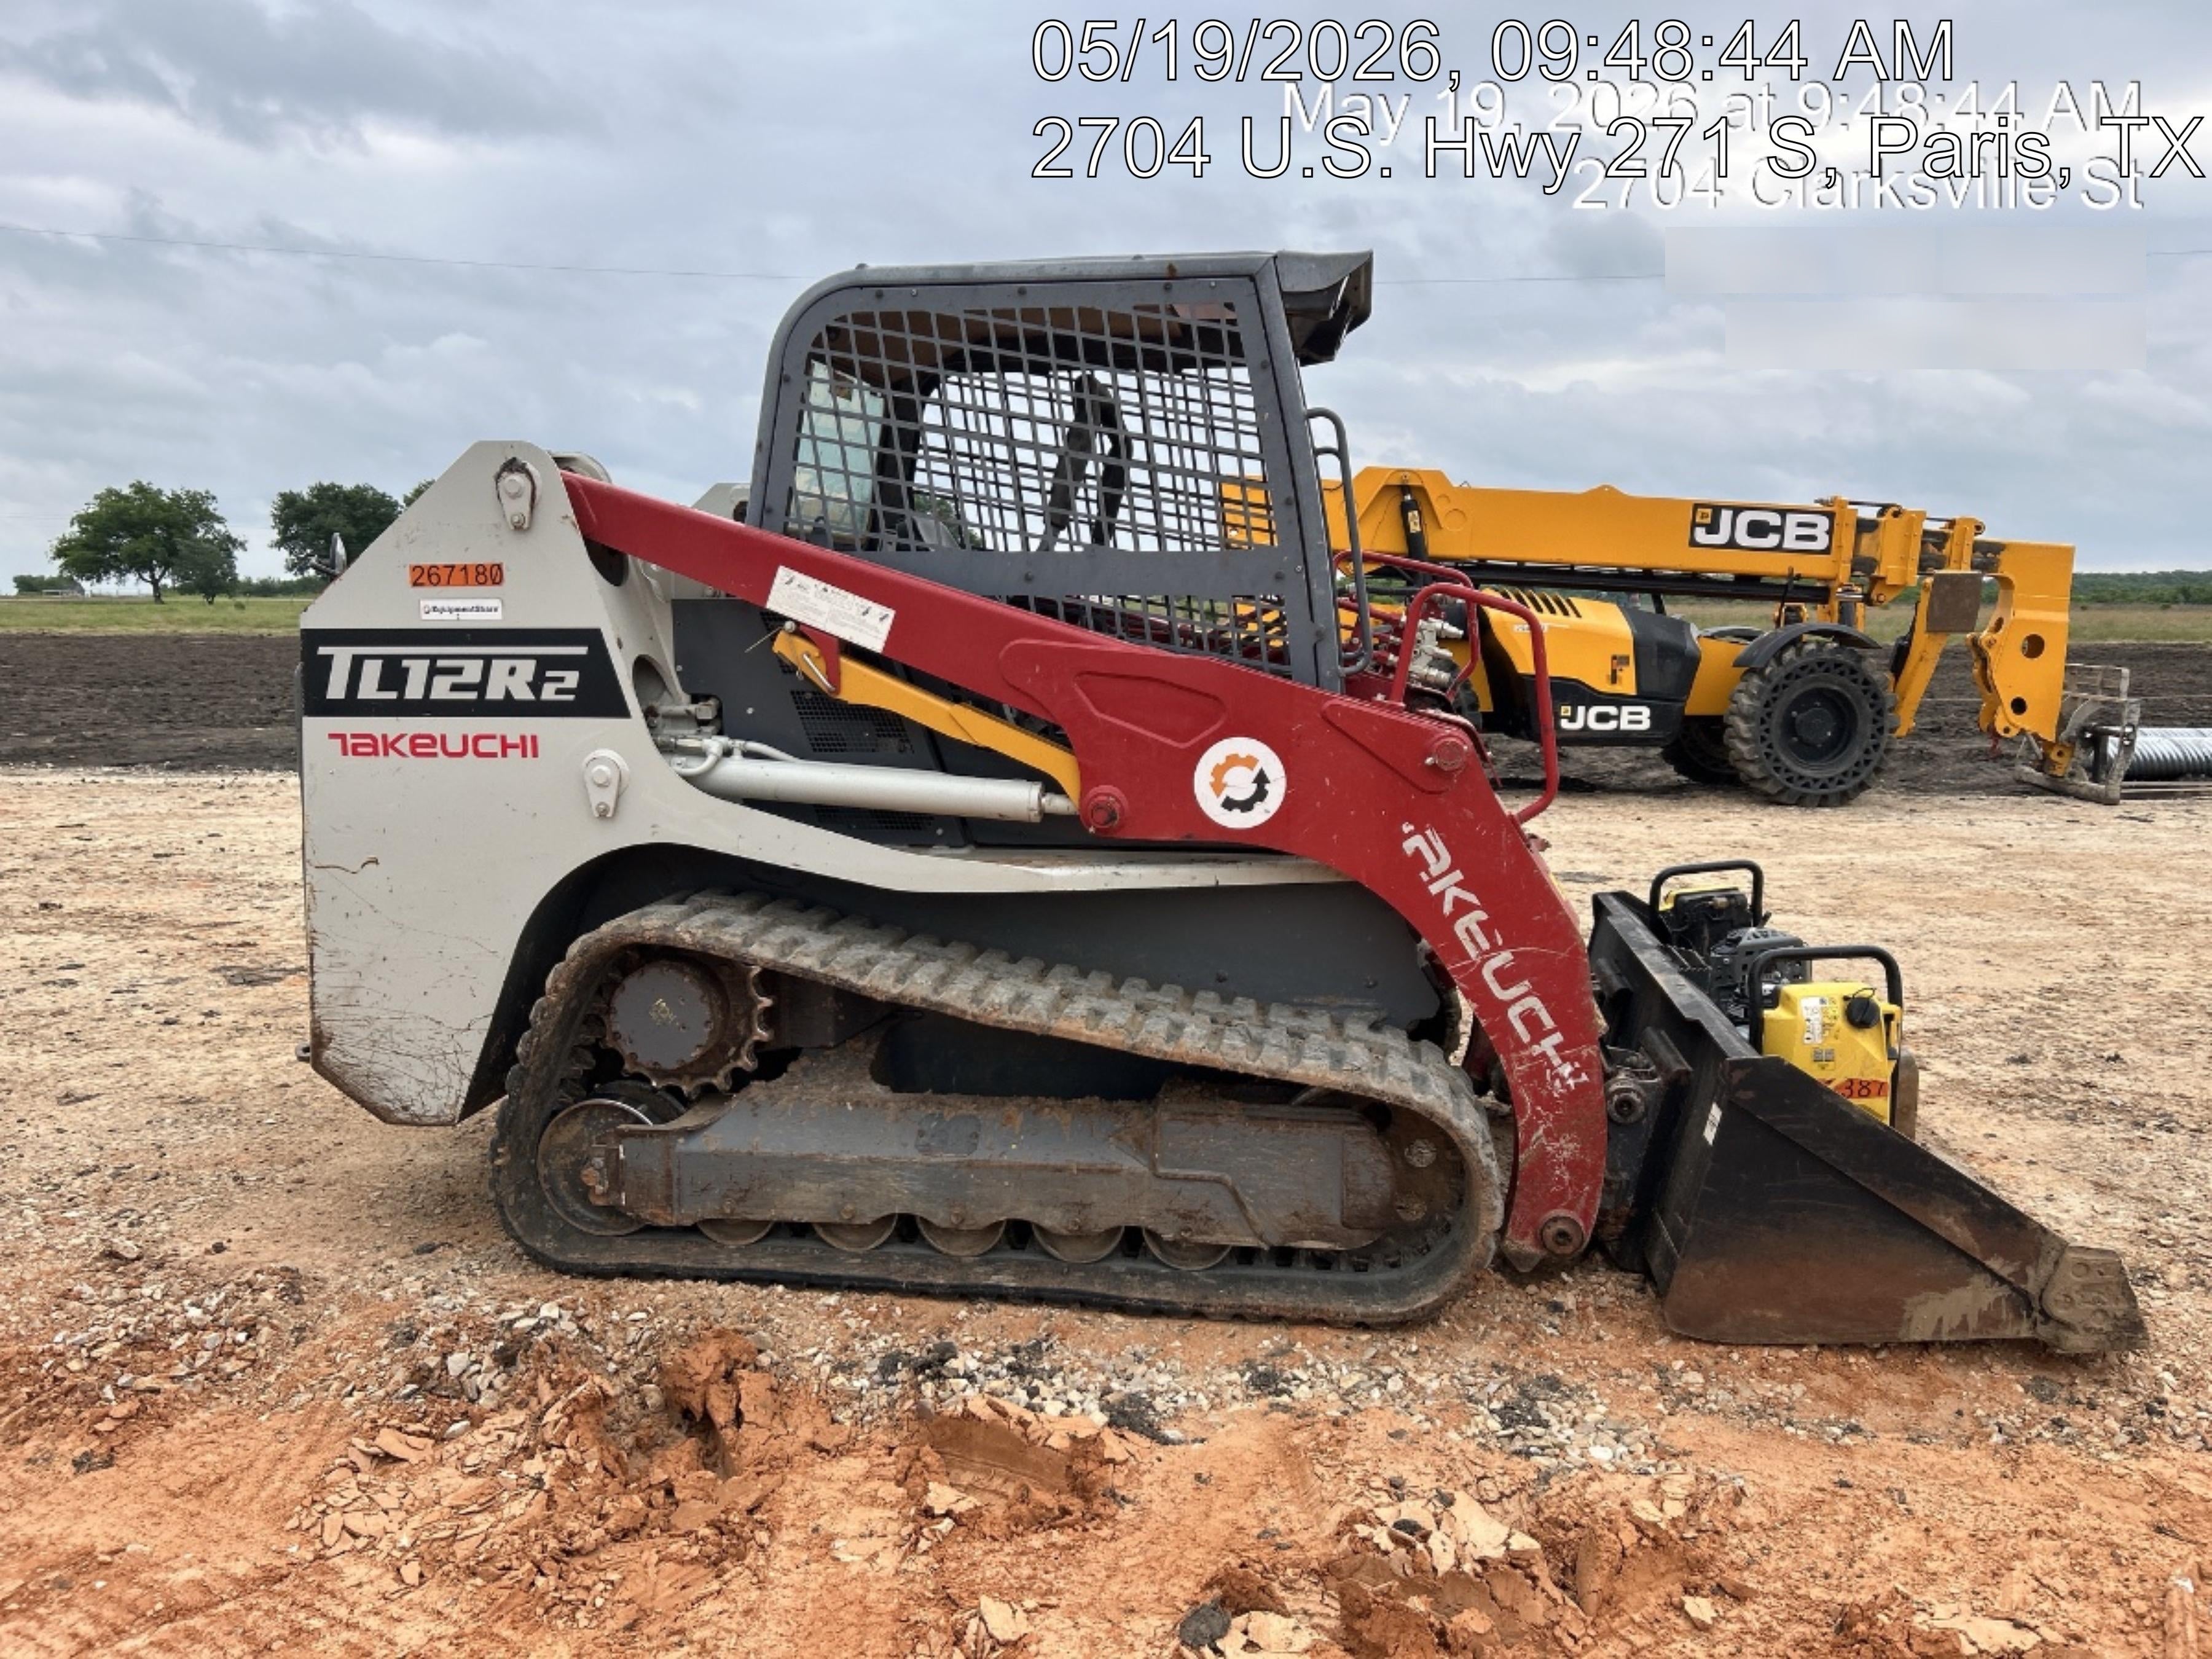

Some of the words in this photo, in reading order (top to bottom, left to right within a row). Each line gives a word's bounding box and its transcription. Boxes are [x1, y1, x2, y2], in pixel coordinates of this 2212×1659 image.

[1693, 508, 1830, 550] JCB
[412, 564, 504, 587] 267180
[317, 646, 588, 701] TL12R2
[1560, 705, 1650, 731] JCB
[327, 733, 538, 758] TAKEUCHI
